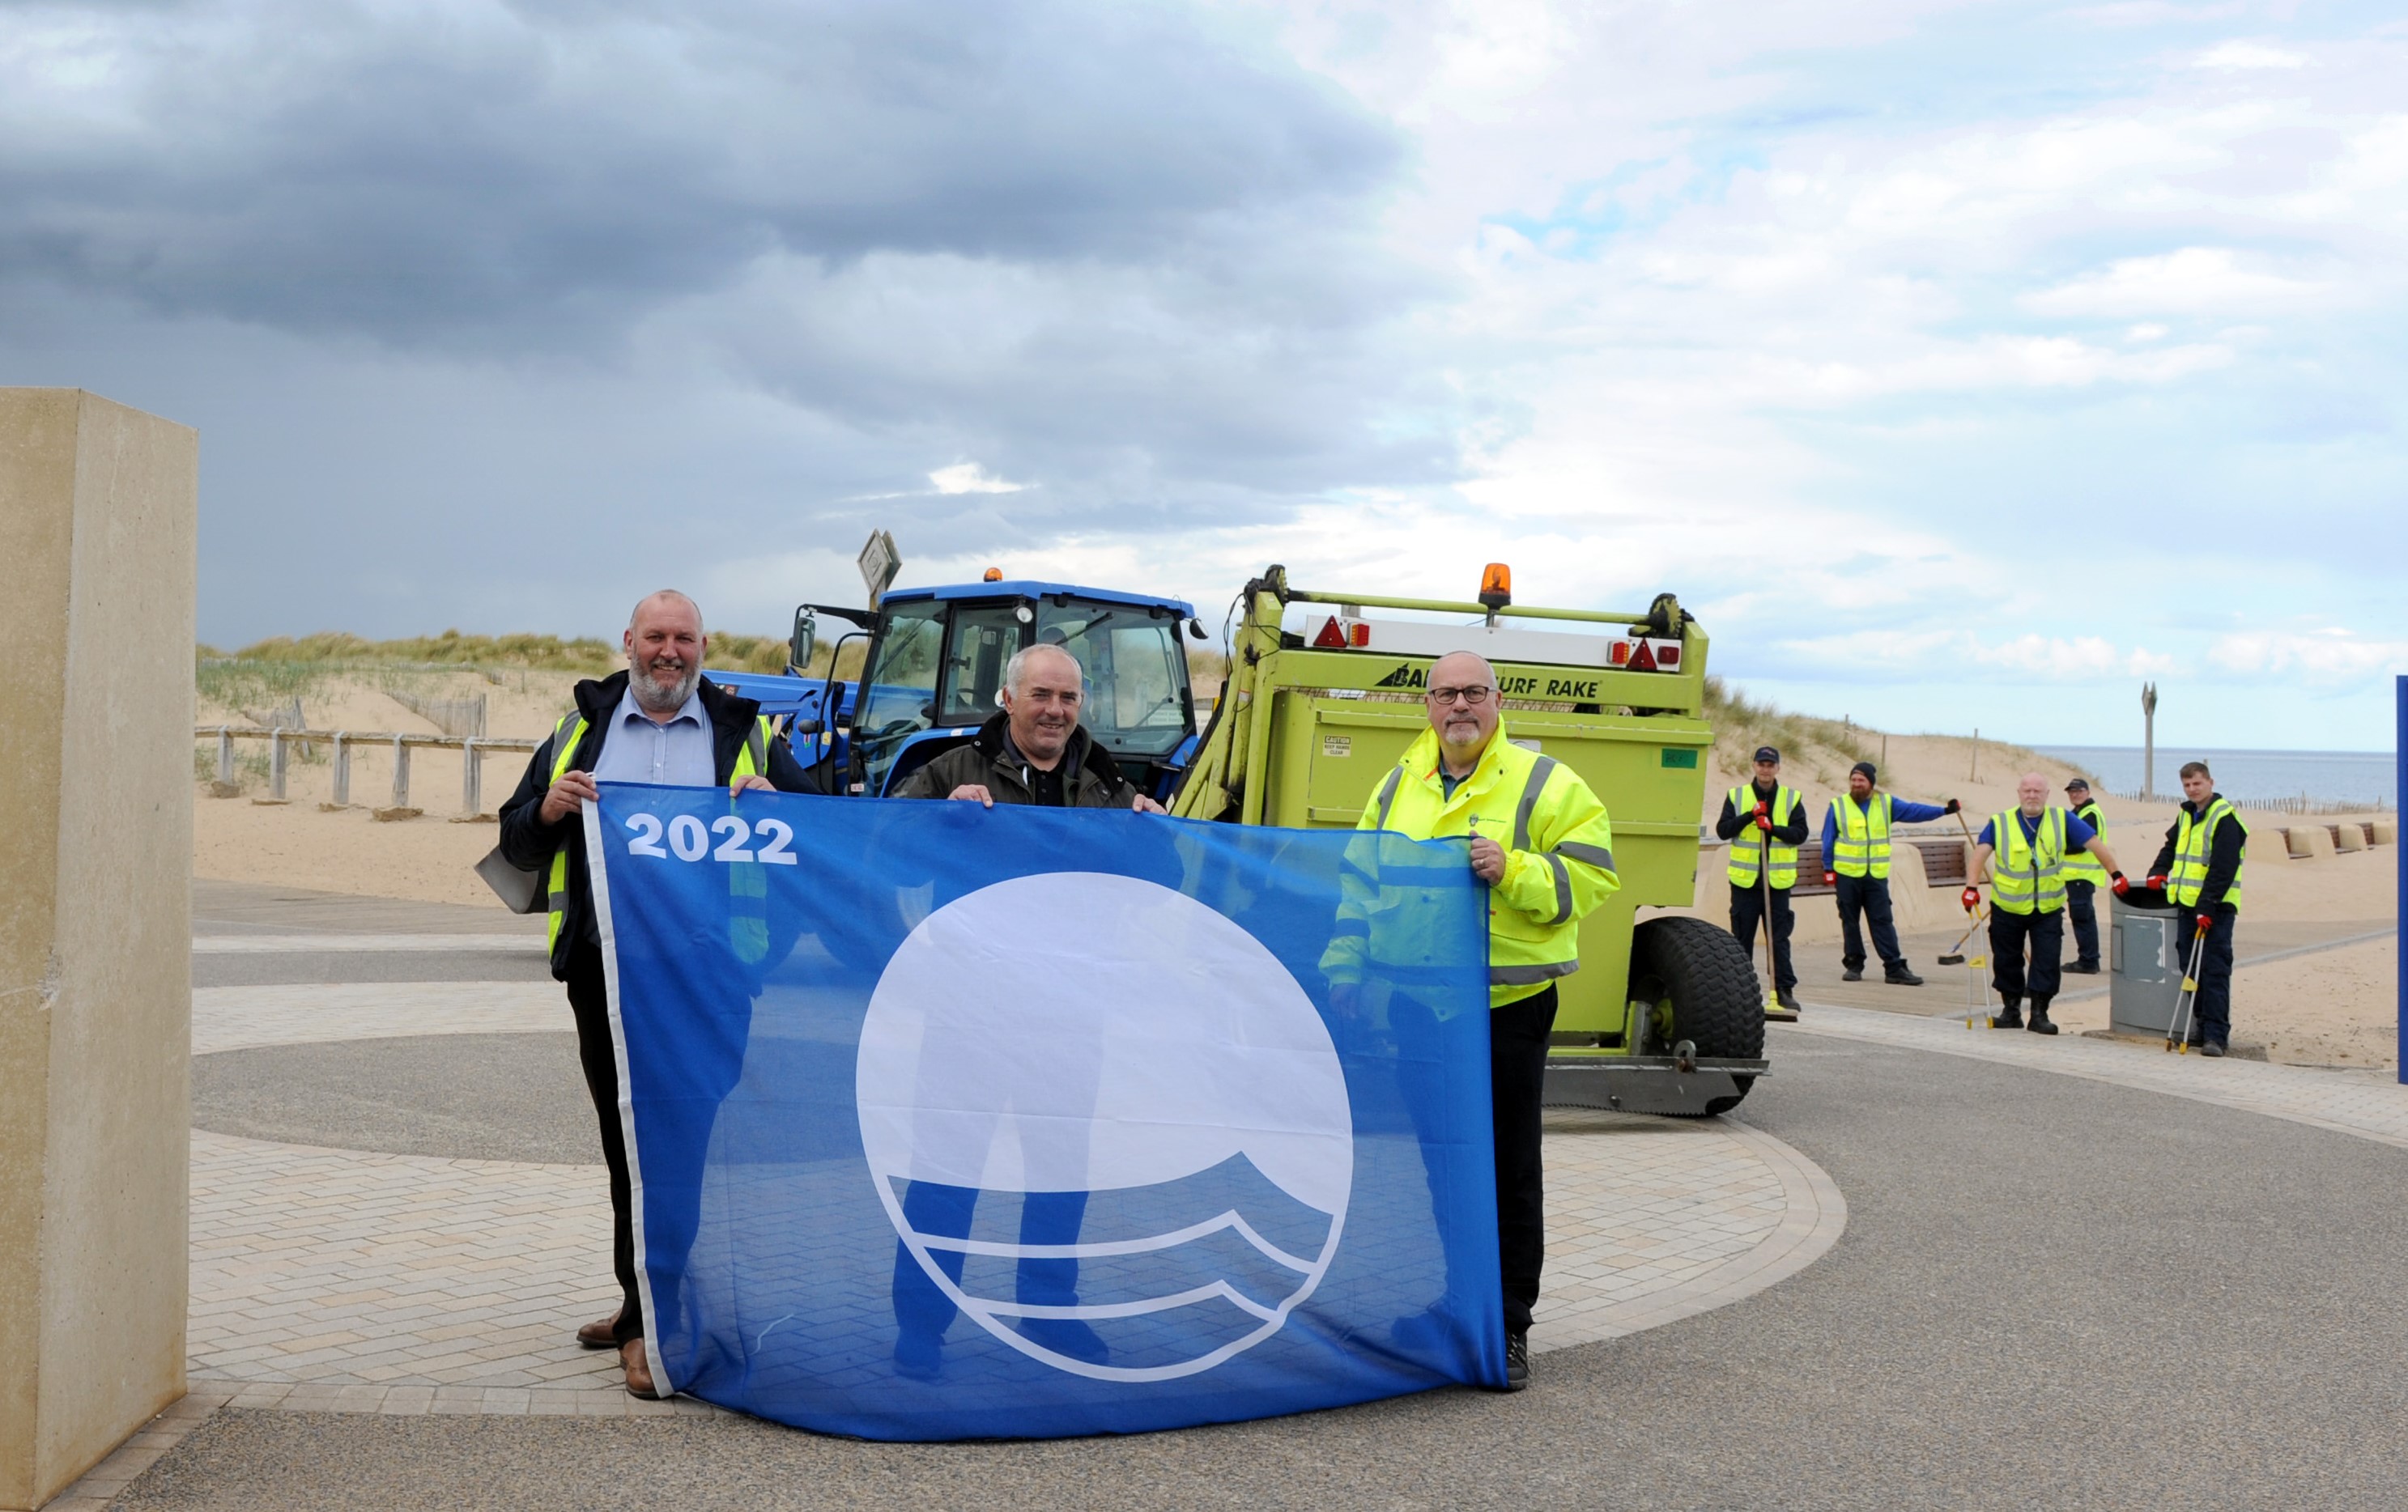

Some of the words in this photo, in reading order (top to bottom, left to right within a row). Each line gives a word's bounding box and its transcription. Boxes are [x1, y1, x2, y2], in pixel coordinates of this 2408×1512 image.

[1495, 676, 1538, 694] URF
[1546, 679, 1598, 699] RAKE
[625, 813, 798, 864] 2022
